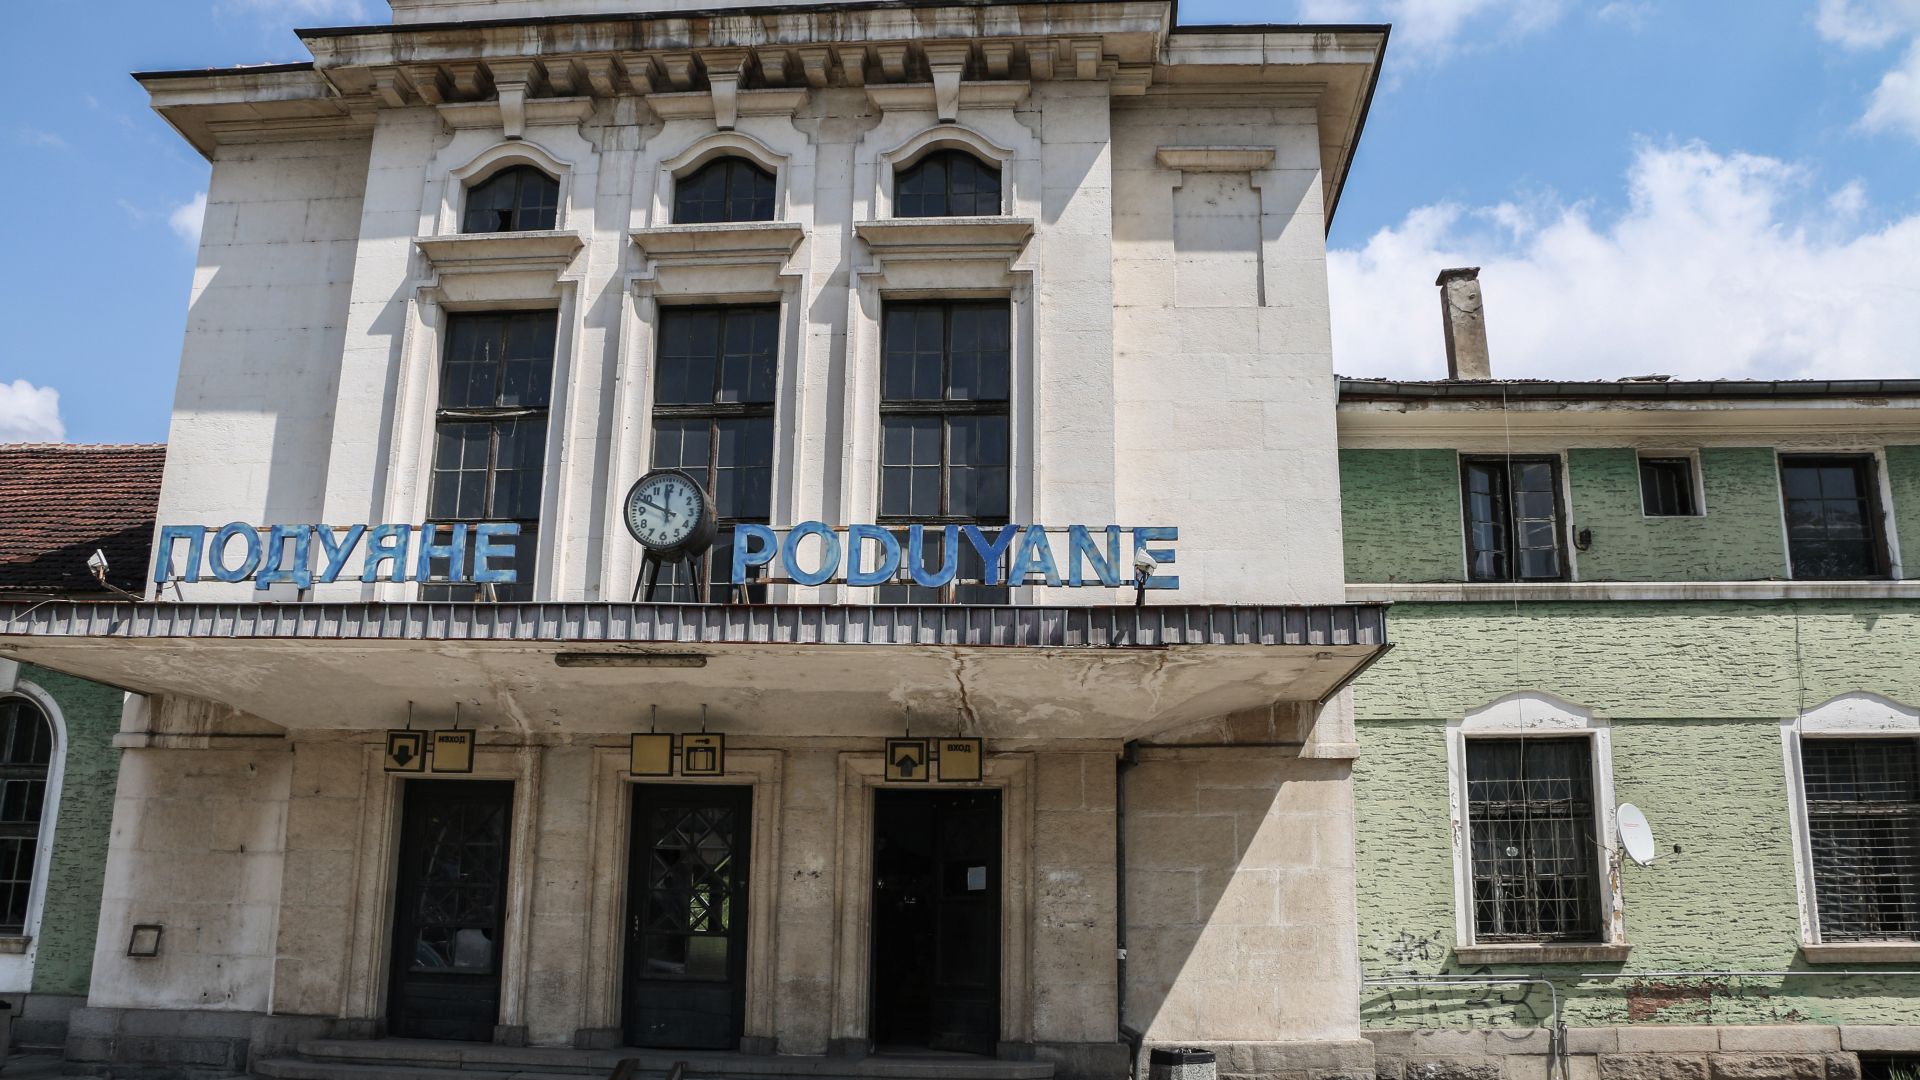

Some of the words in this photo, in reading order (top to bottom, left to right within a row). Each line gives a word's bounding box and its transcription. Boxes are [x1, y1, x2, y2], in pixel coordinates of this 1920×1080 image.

[653, 487, 660, 496] 11
[643, 494, 653, 503] 10
[686, 496, 693, 506] 2
[638, 506, 646, 516] 9
[688, 508, 695, 517] 3
[640, 519, 648, 529] 8
[682, 520, 690, 529] 4
[648, 528, 655, 537] 7
[659, 532, 667, 541] 6
[674, 528, 680, 538] 5
[154, 521, 521, 590] ПОДУЯНЕ
[731, 521, 1180, 589] PODUYANE
[947, 744, 971, 752] ВХОД
